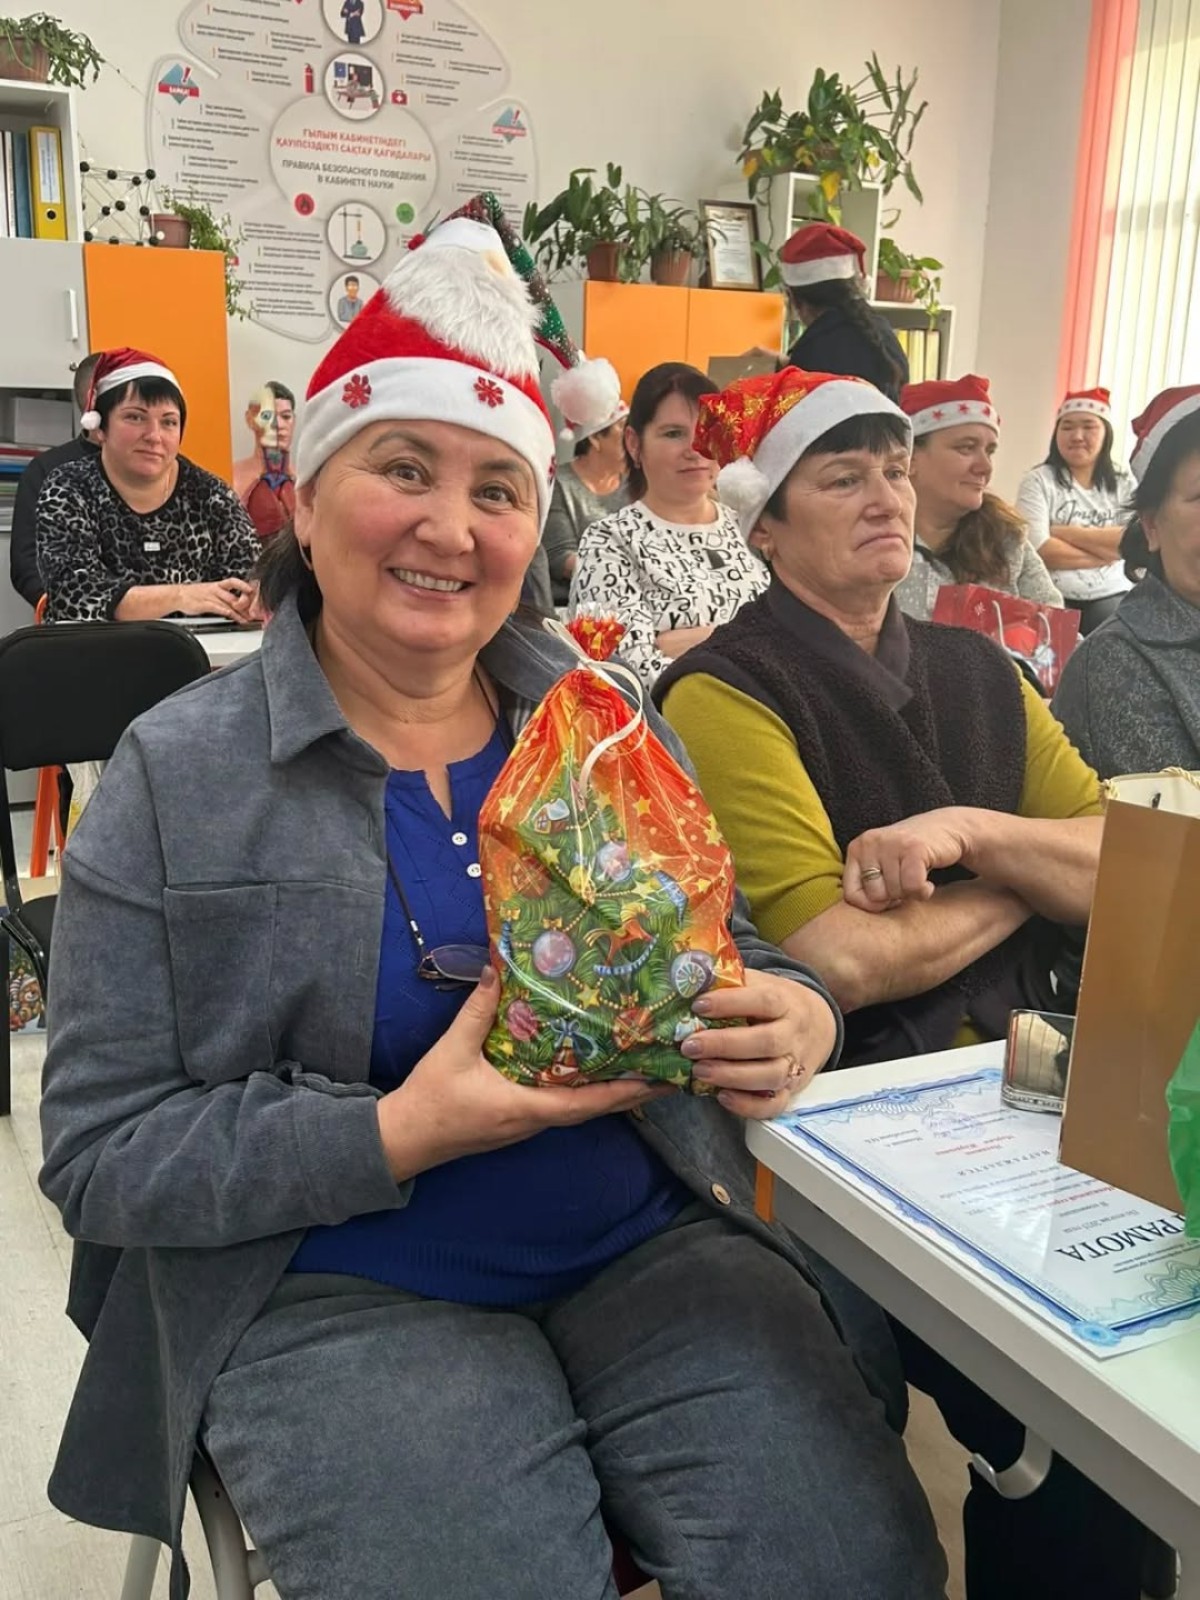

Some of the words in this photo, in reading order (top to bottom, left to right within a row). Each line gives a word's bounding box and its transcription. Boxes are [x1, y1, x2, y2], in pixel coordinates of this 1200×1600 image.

[282, 160, 320, 171] ПРАВИЛА
[322, 164, 378, 176] БЕЗОПАСНОГО
[380, 169, 427, 180] ПОВЕДЕНИЯ
[317, 175, 323, 183] В
[325, 176, 366, 187] КАБИНЕТЕ
[368, 180, 394, 189] НАУКИ
